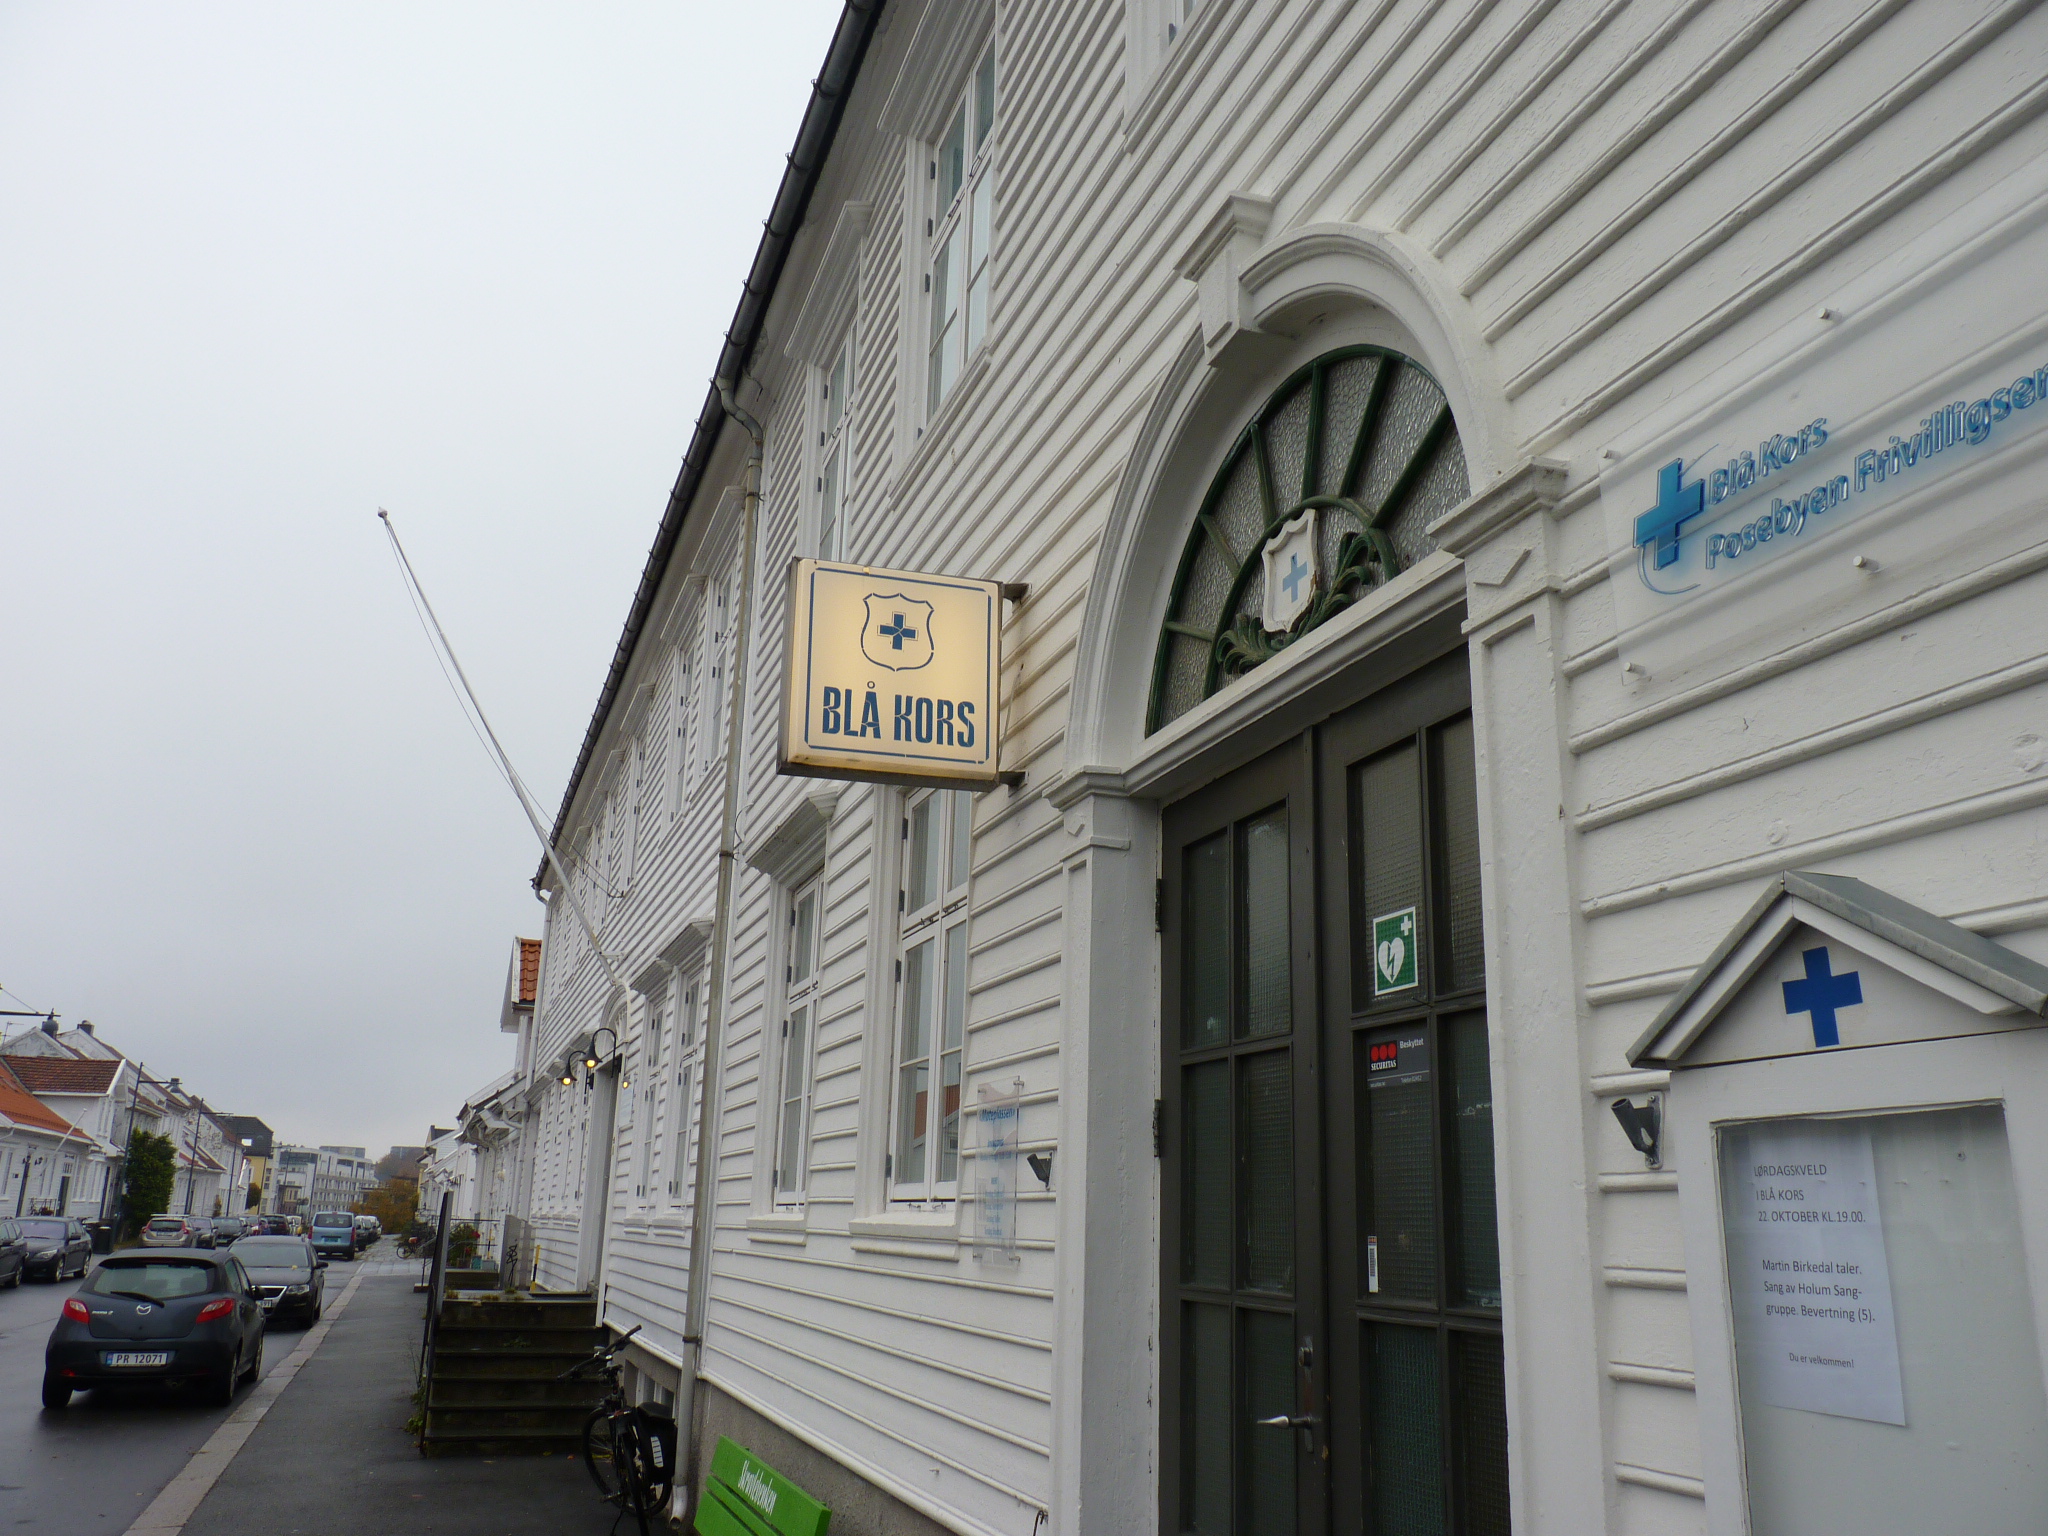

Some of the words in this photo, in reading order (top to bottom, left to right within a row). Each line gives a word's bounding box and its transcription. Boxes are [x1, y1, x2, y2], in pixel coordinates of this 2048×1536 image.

[1709, 450, 1755, 505] Blå
[1758, 417, 1828, 477] Kors
[1705, 475, 1849, 570] Posebyen
[822, 680, 881, 739] BLÅ
[893, 694, 975, 748] KORS
[1399, 1038, 1424, 1049] Beskyttet
[1371, 1059, 1397, 1071] SECURITAS
[1754, 1164, 1827, 1177] LØRDAGSKVELD
[1761, 1187, 1776, 1200] BLÅ
[1778, 1189, 1804, 1200] KORS
[1758, 1210, 1770, 1222] 22.
[1771, 1210, 1819, 1222] OKTOBER
[1762, 1259, 1790, 1272] Martin
[1793, 1260, 1833, 1274] Birkedal
[1836, 1262, 1862, 1275] taler.
[1764, 1281, 1784, 1295] Sang
[1785, 1284, 1796, 1293] av
[1798, 1283, 1831, 1295] Holum
[1833, 1284, 1862, 1300] Sang-
[1766, 1304, 1799, 1317] gruppe.
[1801, 1304, 1855, 1322] Bevertning
[116, 1354, 130, 1364] PR
[134, 1354, 163, 1364] 12071
[1789, 1352, 1799, 1362] Du
[1800, 1355, 1807, 1363] er
[1808, 1355, 1854, 1369] velkommen!
